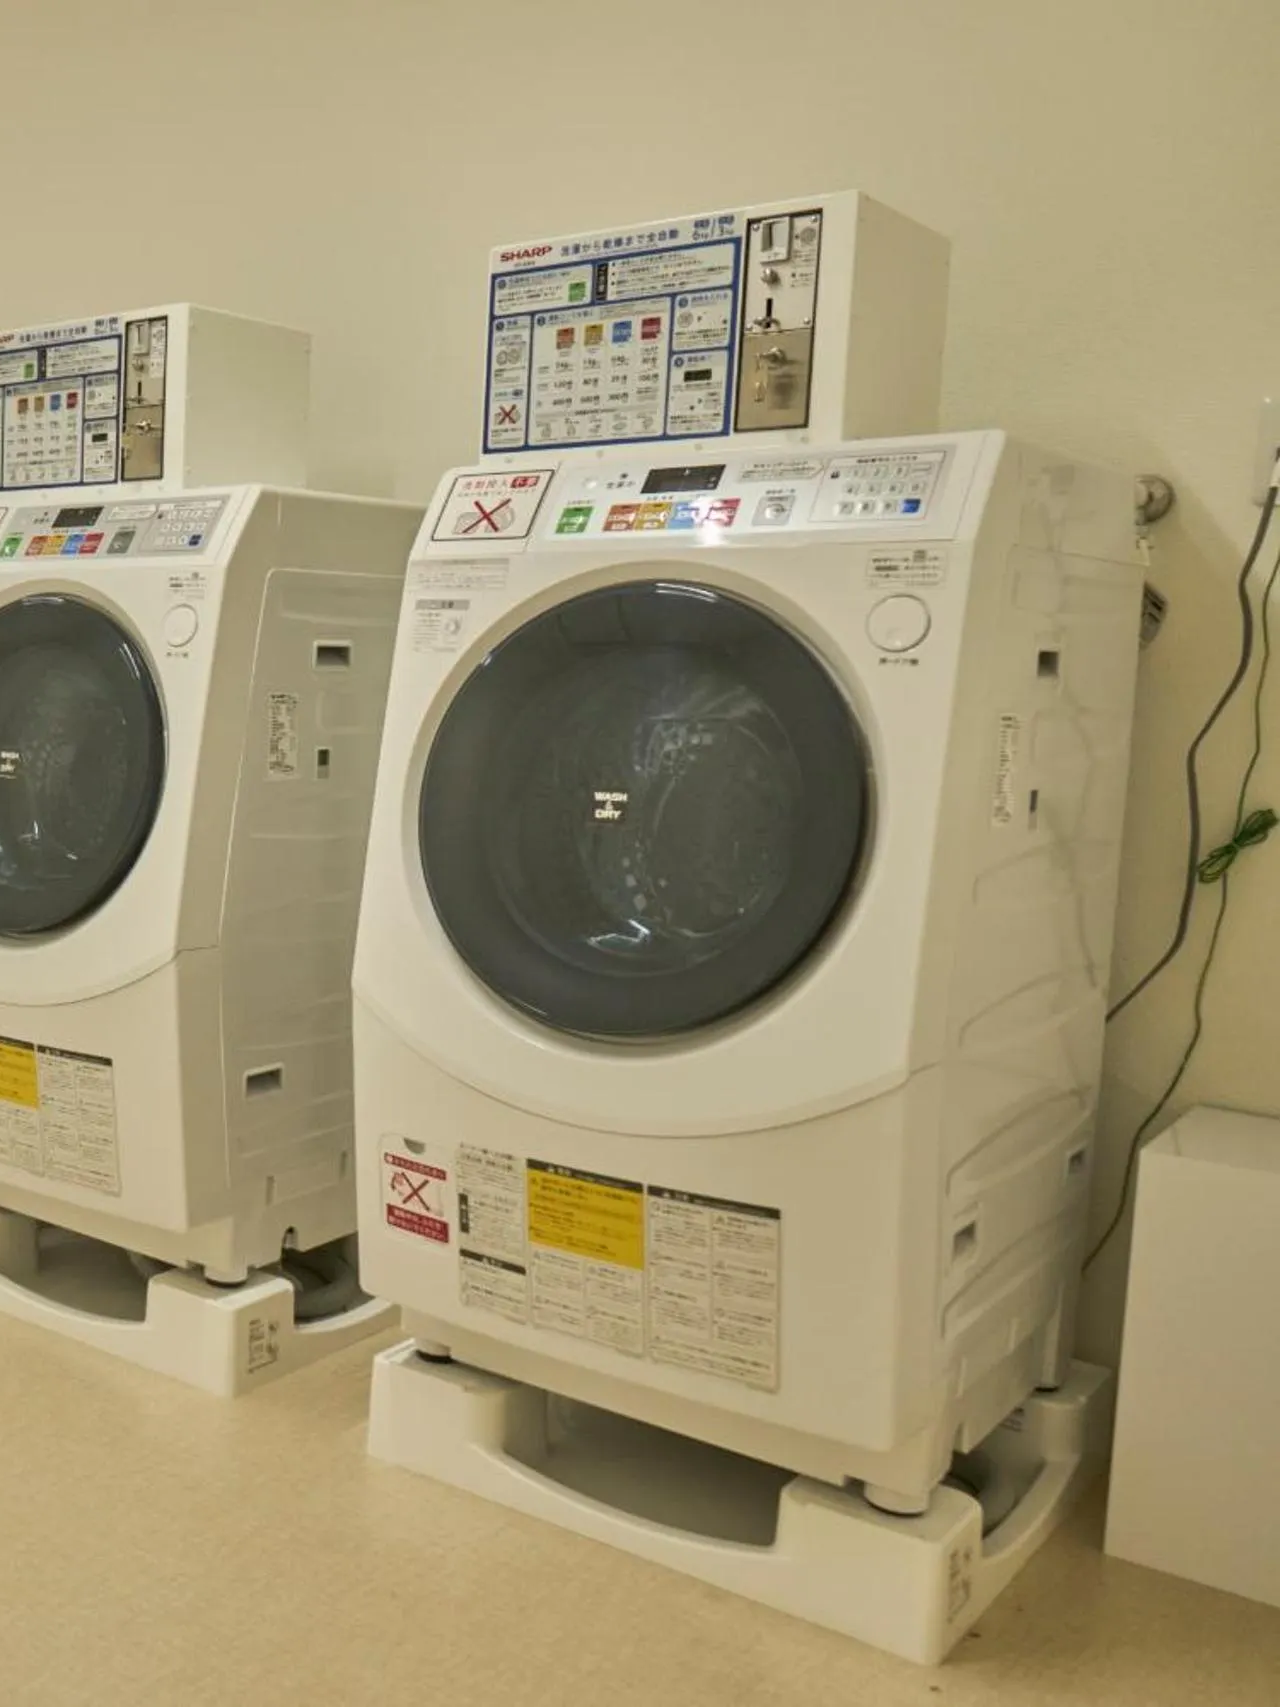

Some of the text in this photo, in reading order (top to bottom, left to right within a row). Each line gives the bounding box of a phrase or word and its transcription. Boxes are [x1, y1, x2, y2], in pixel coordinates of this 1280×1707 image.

[500, 245, 553, 262] SHARP
[593, 791, 628, 802] WASH
[594, 808, 622, 820] DRY
